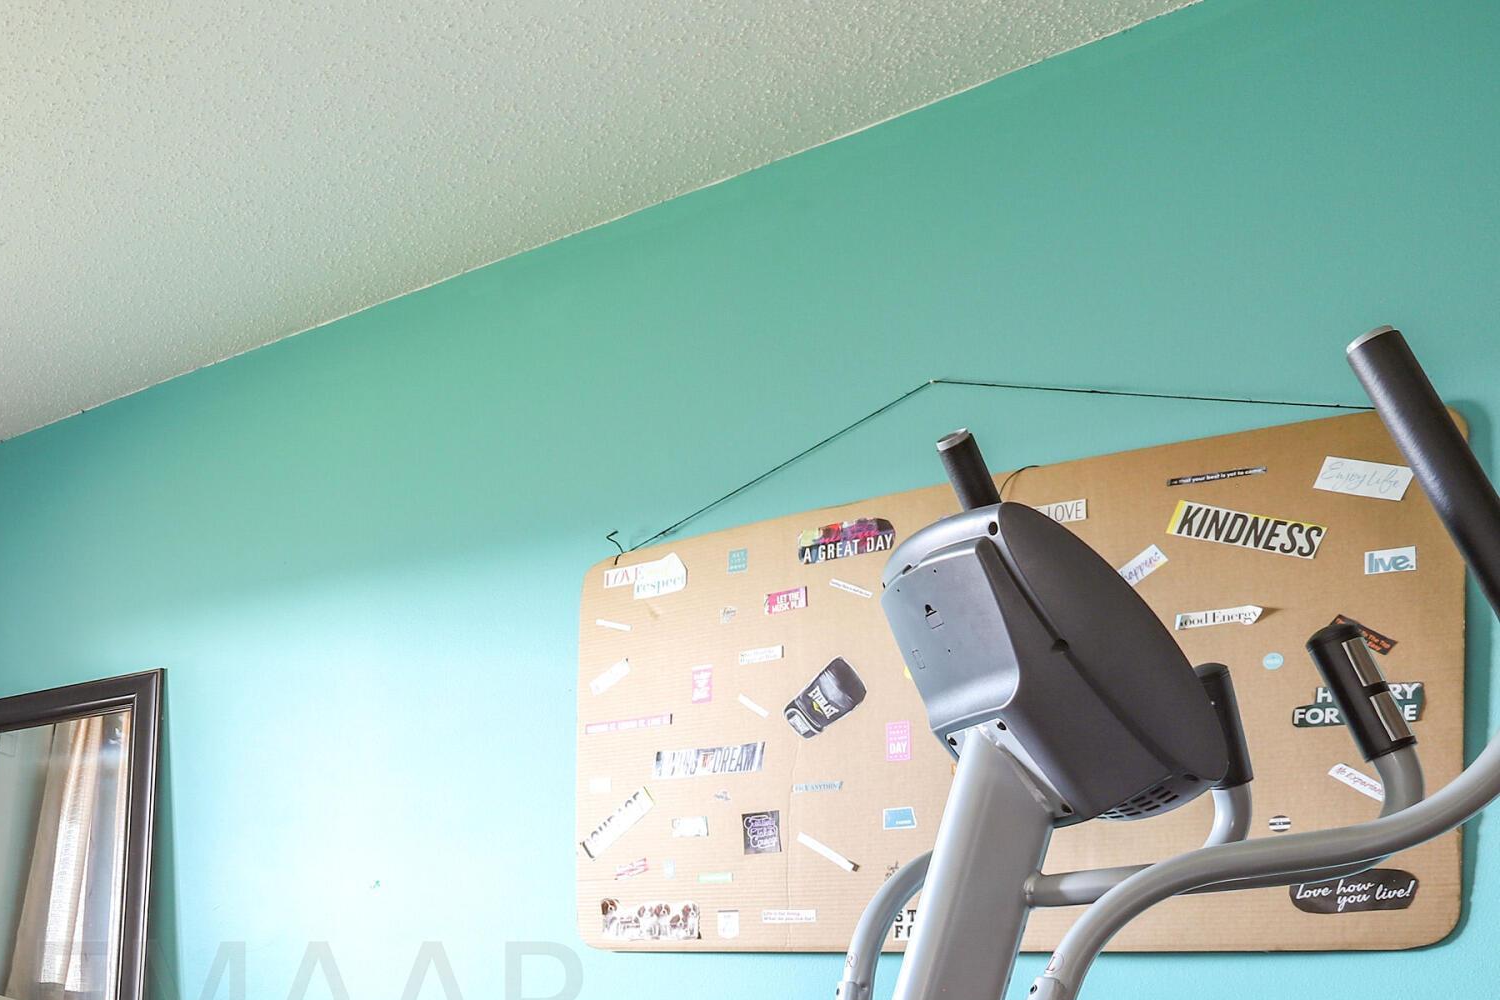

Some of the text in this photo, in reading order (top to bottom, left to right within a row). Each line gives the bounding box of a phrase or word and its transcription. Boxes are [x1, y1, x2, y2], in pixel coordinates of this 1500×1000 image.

[1176, 505, 1323, 557] KINDNESS
[803, 547, 812, 562] A
[818, 539, 860, 561] GREAT
[866, 533, 893, 553] DAY
[1367, 553, 1415, 574] live.
[1180, 609, 1258, 628] ood Energy
[807, 685, 840, 720] EVERLAST
[1293, 707, 1341, 725] FOR
[712, 745, 755, 774] DREAM
[889, 741, 908, 754] DAY
[1296, 879, 1374, 900] Love how
[1337, 880, 1416, 912] you live!
